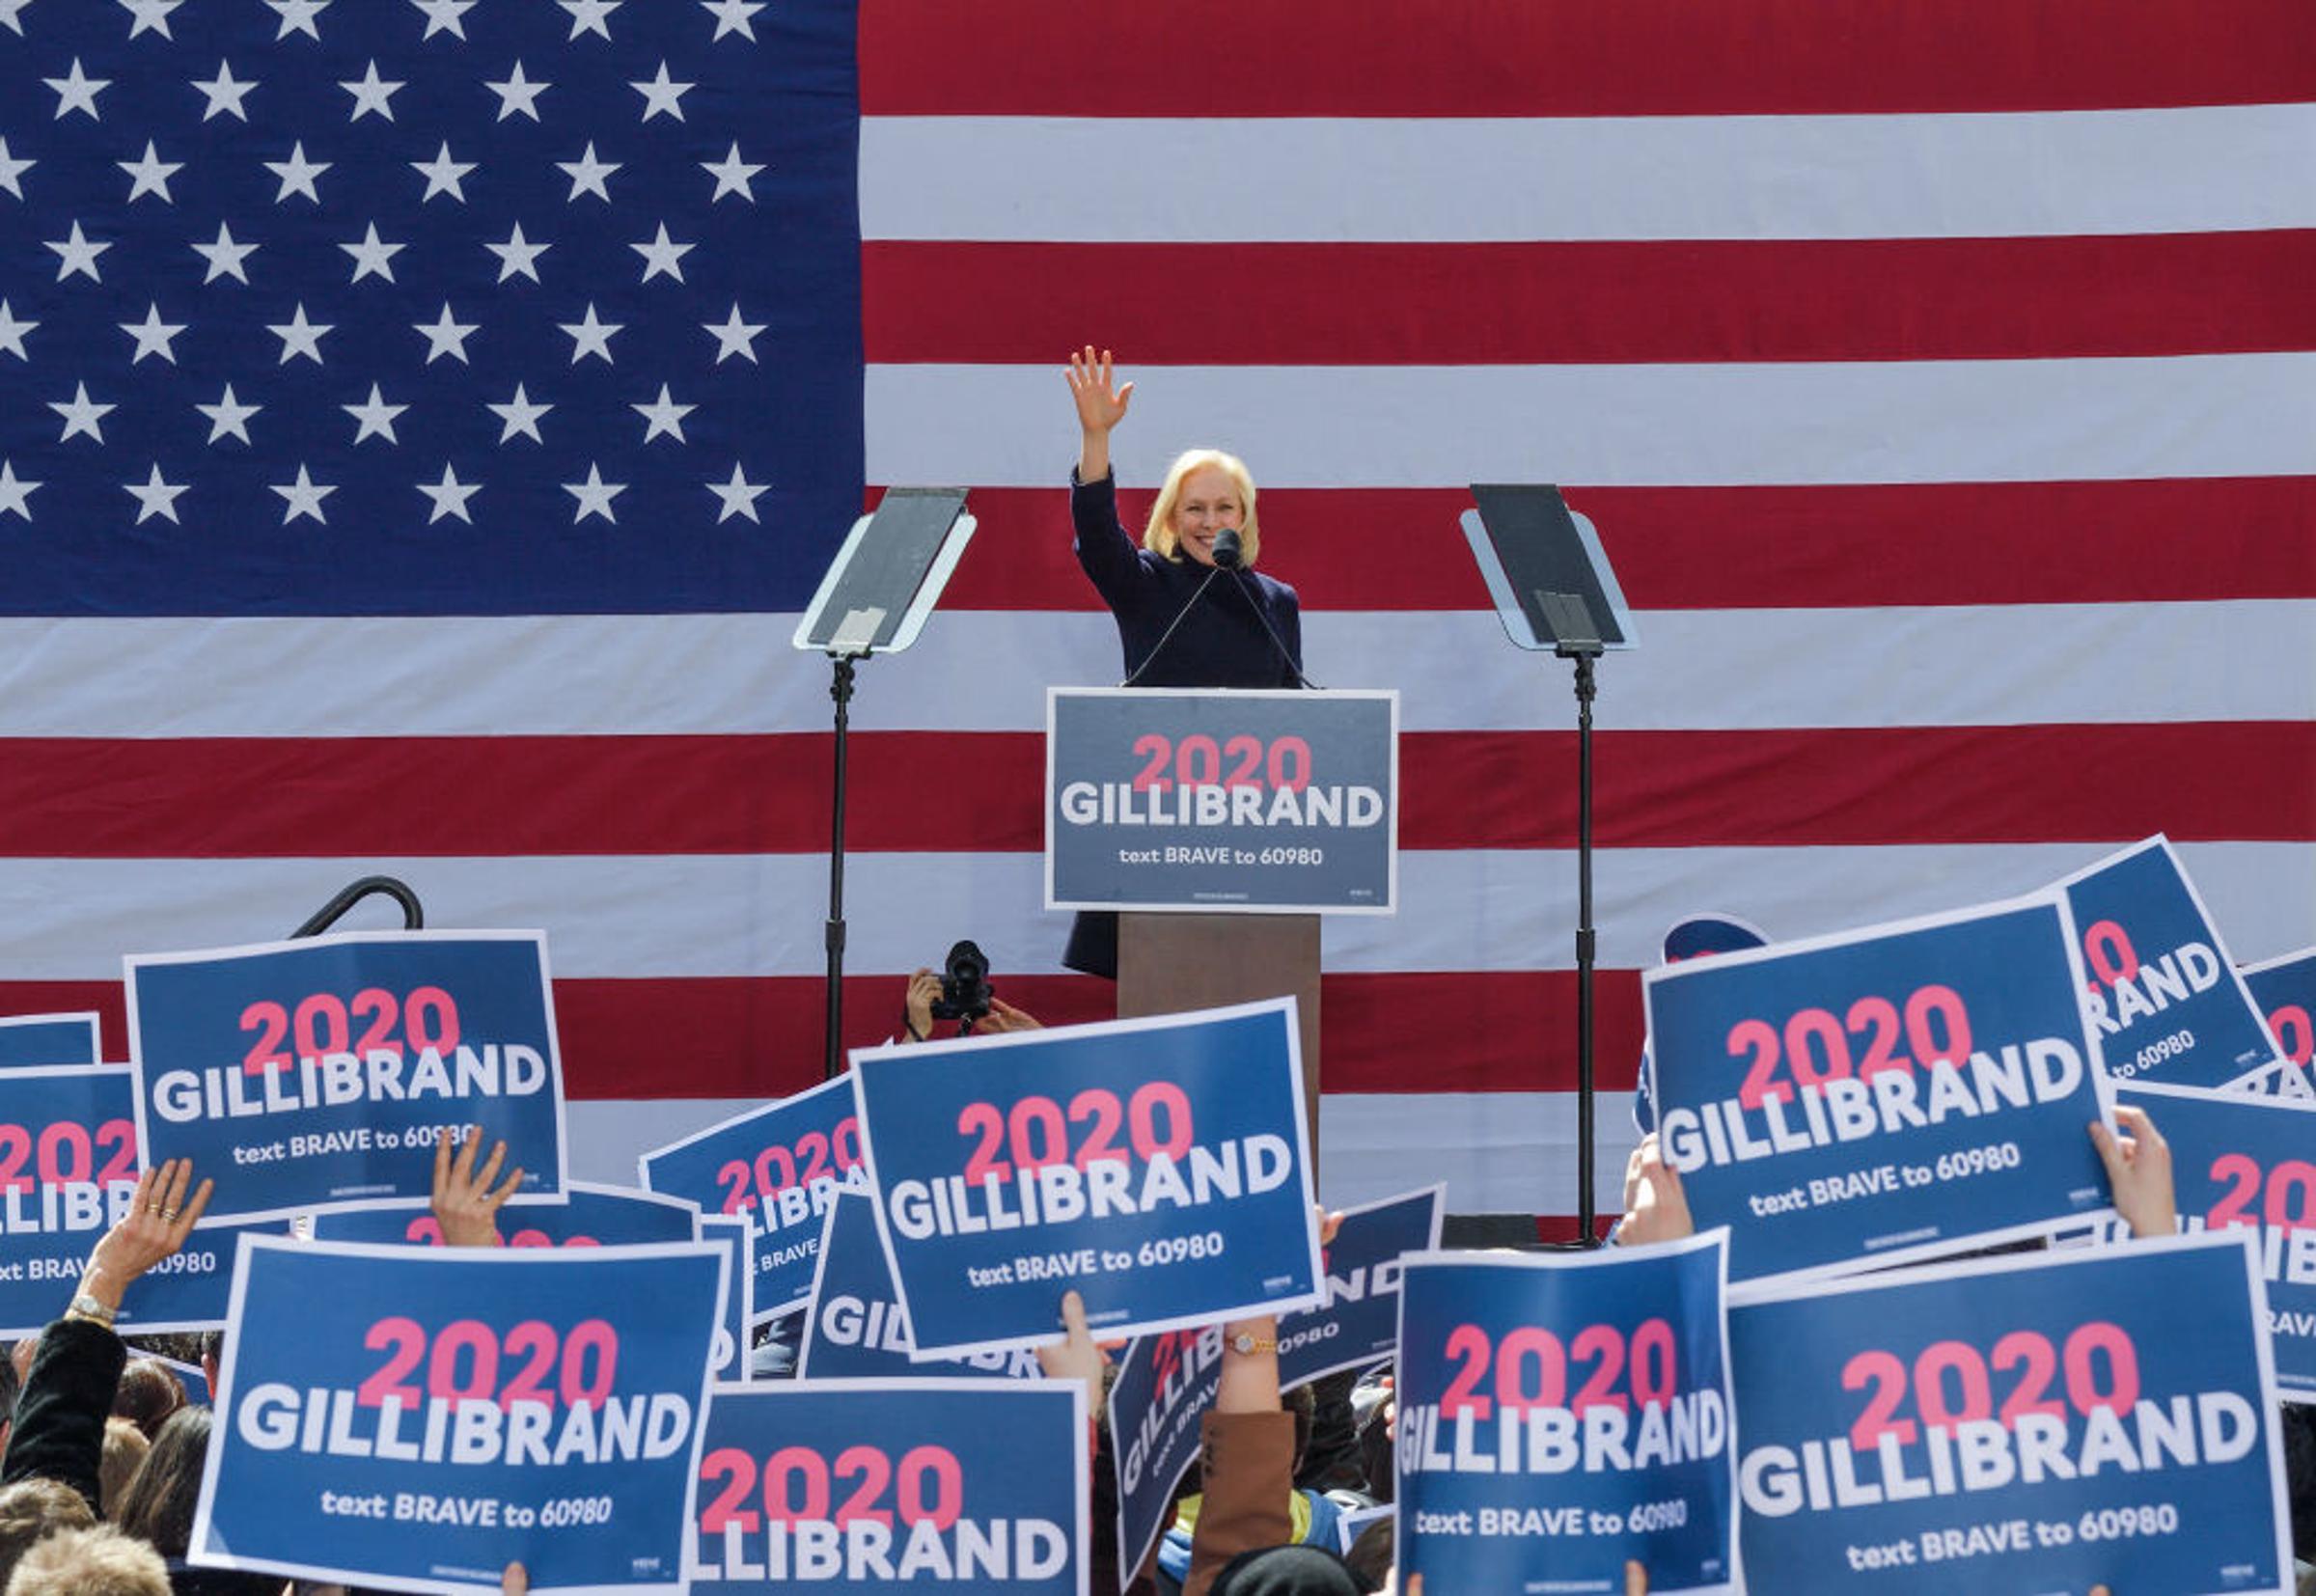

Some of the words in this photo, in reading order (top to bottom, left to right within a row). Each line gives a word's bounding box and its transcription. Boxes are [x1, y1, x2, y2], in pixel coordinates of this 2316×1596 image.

[1132, 734, 1312, 794] 2020
[1061, 782, 1384, 828] GILLIBRAND
[1118, 848, 1161, 865] text
[1165, 846, 1229, 865] BRAVE
[1234, 849, 1256, 865] to
[1259, 847, 1323, 866] 60980
[239, 985, 460, 1077] 2020
[1726, 984, 1973, 1111] 2020
[2136, 1029, 2196, 1070] 60980
[152, 1044, 546, 1123] GILLIBRAND
[1662, 1037, 2083, 1173] GILLIBRAND
[233, 1141, 286, 1165] text
[290, 1127, 372, 1158] BRAVE
[374, 1131, 400, 1149] to
[957, 1081, 1194, 1188] 2020
[890, 1134, 1293, 1241] GILLIBRAND
[1748, 1183, 1809, 1217] text
[1807, 1165, 1901, 1205] BRAVE
[1901, 1165, 1933, 1188] to
[1936, 1142, 2021, 1182] 60980
[759, 1237, 819, 1272] BRAVE
[966, 1262, 1014, 1288] text
[1014, 1249, 1098, 1282] BRAVE
[1101, 1250, 1133, 1272] to
[1137, 1230, 1225, 1267] 60980
[356, 1316, 619, 1415] 2020
[1438, 1317, 1677, 1422] 2020
[1841, 1321, 2140, 1451] 2020
[237, 1383, 692, 1466] GILLIBRAND
[1401, 1390, 1725, 1475] GILLIBRAND
[1739, 1391, 2258, 1517] GILLIBRAND
[320, 1490, 388, 1519] text
[393, 1493, 499, 1527] BRAVE
[503, 1503, 536, 1527] to
[539, 1496, 613, 1527] 60980
[699, 1445, 963, 1533] 2020
[1415, 1509, 1474, 1536] text
[1477, 1507, 1585, 1536] BRAVE
[1588, 1510, 1624, 1535] to
[1627, 1499, 1688, 1534] 60980
[1845, 1539, 1916, 1571] text
[1920, 1520, 2031, 1562] BRAVE
[2034, 1522, 2074, 1547] to
[2078, 1502, 2179, 1542] 60980
